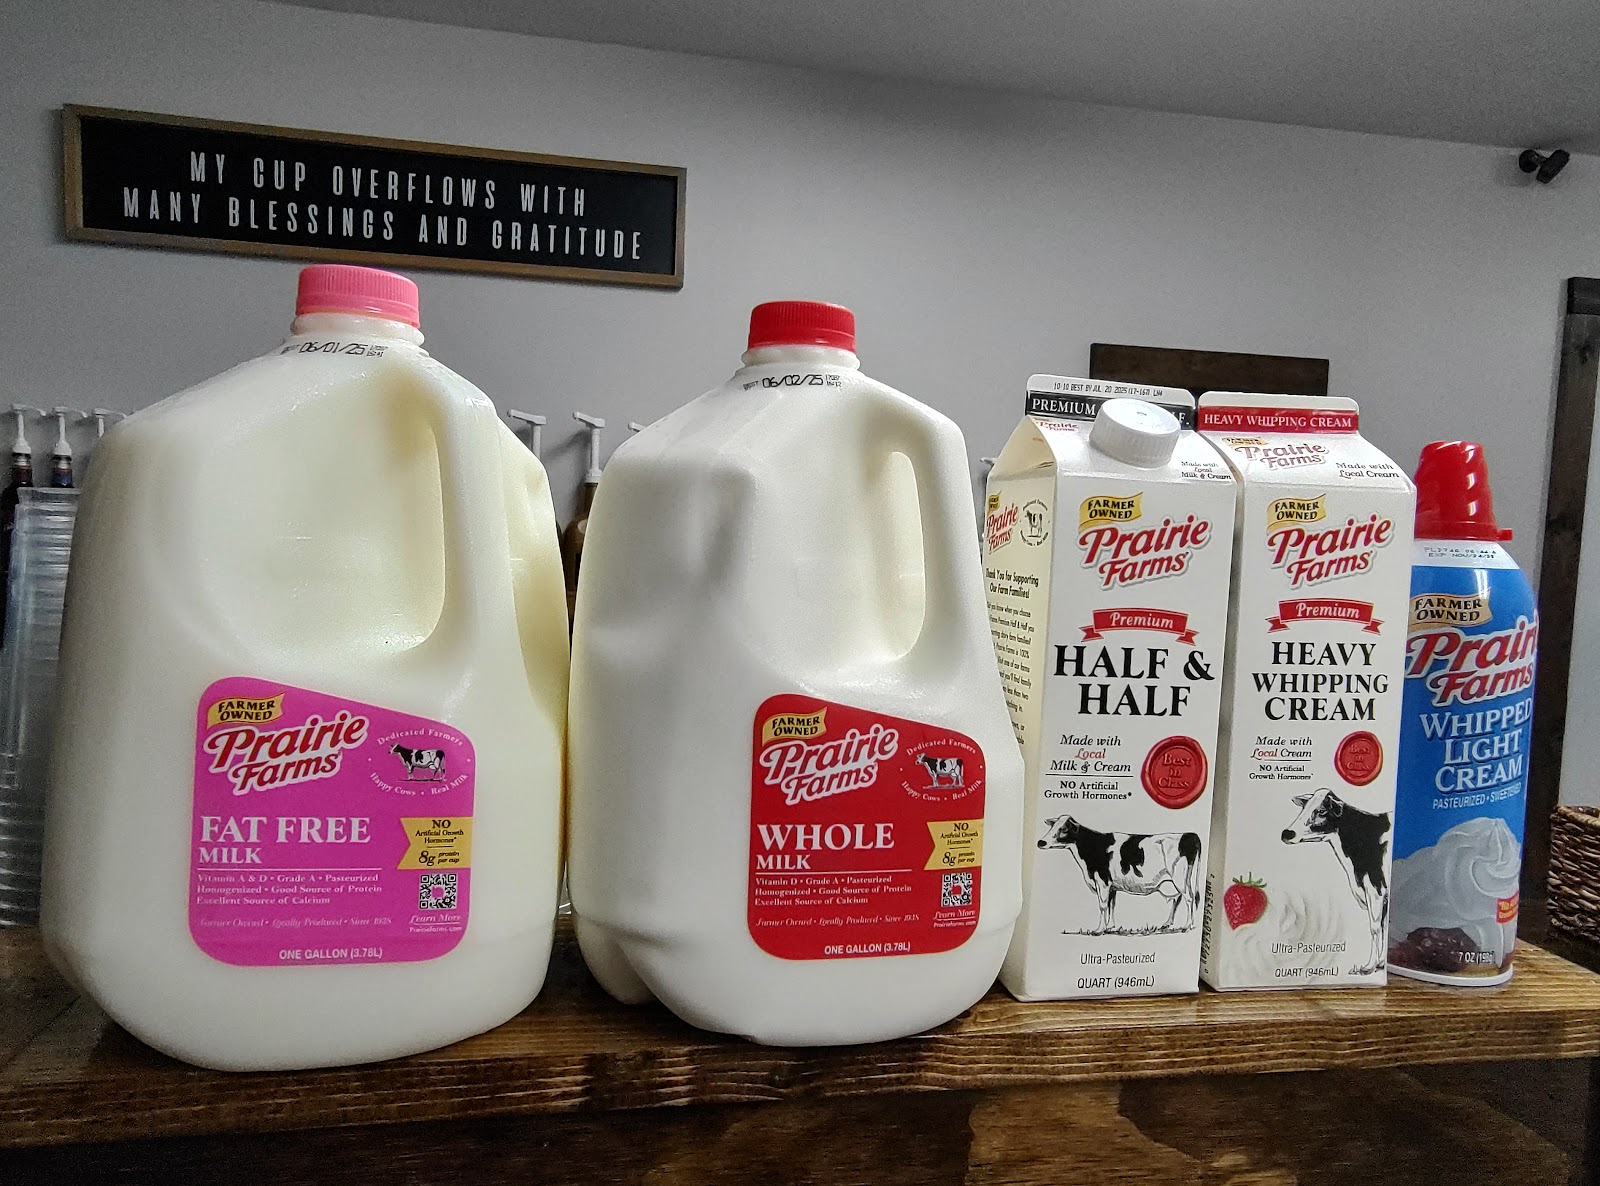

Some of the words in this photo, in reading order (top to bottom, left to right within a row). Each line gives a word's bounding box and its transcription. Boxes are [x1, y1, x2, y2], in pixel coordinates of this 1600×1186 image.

[190, 151, 226, 185] MY
[253, 157, 306, 191] CUP
[332, 165, 497, 210] OVERFLOWS
[520, 183, 586, 217] WITH
[123, 187, 202, 224] MANY
[228, 196, 395, 241] BLESSINGS
[418, 214, 468, 247] AND
[491, 220, 642, 260] GRATITUDE
[299, 342, 368, 355] 06/01/25
[762, 374, 824, 388] 06/02/25
[1070, 384, 1084, 392] BEST
[1086, 384, 1093, 392] BY
[1032, 398, 1096, 416] PREMIUM
[1204, 414, 1243, 425] HEAVY
[1246, 414, 1307, 427] WHIPPING
[1310, 417, 1352, 428] CREAM
[1235, 443, 1326, 460] Prairie
[1260, 454, 1323, 469] Farms
[1338, 470, 1364, 478] Local
[1366, 470, 1400, 478] Cream
[1088, 500, 1135, 510] FARMER
[1274, 501, 1320, 512] FARMER
[1088, 509, 1133, 520] OWNED
[1276, 510, 1318, 520] OWNED
[1078, 514, 1209, 565] Prairie
[1267, 514, 1392, 565] Prairie
[1098, 552, 1187, 587] Farms
[1286, 551, 1371, 586] Farms
[1296, 602, 1360, 619] Premium
[1414, 598, 1482, 612] FARMER
[1110, 612, 1174, 628] Premium
[1416, 609, 1480, 622] OWNED
[1272, 641, 1376, 666] HEAVY
[1053, 644, 1169, 680] HALF
[1183, 650, 1216, 681] &
[1252, 672, 1389, 694] WHIPPING
[1430, 662, 1534, 704] Farms
[218, 700, 276, 713] FARMER
[1077, 683, 1191, 717] HALF
[1264, 696, 1376, 721] CREAM
[219, 710, 273, 722] OWNED
[772, 716, 820, 730] FARMER
[1420, 697, 1533, 739] WHIPPED
[377, 728, 424, 746] Dedicated
[428, 728, 464, 746] Farmers
[774, 726, 818, 737] OWNED
[206, 712, 366, 769] Prairie
[906, 738, 946, 756] Dedicated
[948, 738, 976, 754] Farmers
[1059, 734, 1094, 746] Made
[1096, 736, 1122, 746] with
[1254, 736, 1286, 746] Made
[1290, 736, 1312, 746] with
[1444, 728, 1523, 766] LIGHT
[763, 726, 896, 782] Prairie
[1075, 748, 1106, 760] Local
[1162, 753, 1192, 766] Best
[1250, 748, 1278, 760] Local
[1280, 750, 1312, 758] Cream
[232, 752, 341, 792] Farms
[1050, 760, 1078, 771] Milk
[1080, 763, 1091, 774] &
[1094, 760, 1131, 772] Cream
[1168, 768, 1182, 778] in
[1435, 754, 1523, 793] CREAM
[370, 772, 393, 792] Happy
[394, 786, 416, 796] Cows
[784, 764, 874, 802] Farms
[1060, 780, 1076, 790] NO
[1079, 781, 1118, 790] Artificial
[1158, 777, 1190, 789] Class
[1044, 790, 1079, 800] Growth
[1432, 794, 1486, 810] PASTEURIZED
[200, 816, 268, 843] FAT
[275, 816, 372, 844] FREE
[432, 819, 452, 829] NO
[953, 822, 969, 832] NO
[756, 822, 895, 851] WHOLE
[198, 847, 262, 864] MILK
[418, 850, 436, 866] 8g
[756, 854, 812, 870] MILK
[942, 852, 957, 866] 8g
[198, 874, 236, 883] Vitamin
[239, 874, 246, 882] A
[259, 874, 268, 882] D
[276, 874, 306, 882] Grade
[308, 874, 316, 882] A
[325, 874, 379, 882] Pasteurized
[755, 877, 788, 886] Vitamin
[790, 878, 798, 886] D
[805, 876, 831, 885] Grade
[832, 876, 839, 885] A
[846, 876, 892, 884] Pasteurized
[196, 885, 262, 895] Homogenized
[270, 886, 298, 894] Good
[299, 886, 332, 894] Source
[334, 885, 344, 894] of
[348, 884, 382, 893] Protein
[754, 888, 811, 898] Homogenized
[842, 886, 870, 894] Source
[871, 886, 880, 894] of
[883, 884, 912, 893] Protein
[196, 896, 240, 906] Excellent
[243, 896, 276, 905] Source
[278, 896, 289, 905] of
[292, 896, 330, 905] Calcium
[754, 898, 792, 906] Excellent
[794, 898, 823, 906] Source
[824, 897, 834, 905] of
[836, 896, 868, 905] Calcium
[410, 914, 436, 924] Learn
[438, 914, 462, 922] More
[933, 911, 956, 920] Learn
[958, 909, 976, 917] More
[278, 950, 302, 960] ONE
[304, 949, 348, 959] GALLON
[350, 948, 383, 959] (3.78L)
[824, 946, 844, 955] ONE
[846, 944, 882, 954] GALLON
[884, 942, 911, 953] (3.78L)
[1271, 941, 1346, 954] Ultra-Pasteurized
[1080, 952, 1156, 965] Ultra-Pasteurized
[1458, 952, 1464, 962] 7
[1464, 952, 1476, 962] OZ
[1274, 967, 1302, 978] QUART
[1304, 966, 1340, 978] (946mL)
[1077, 976, 1111, 989] QUART
[1114, 976, 1155, 989] (946mL)
